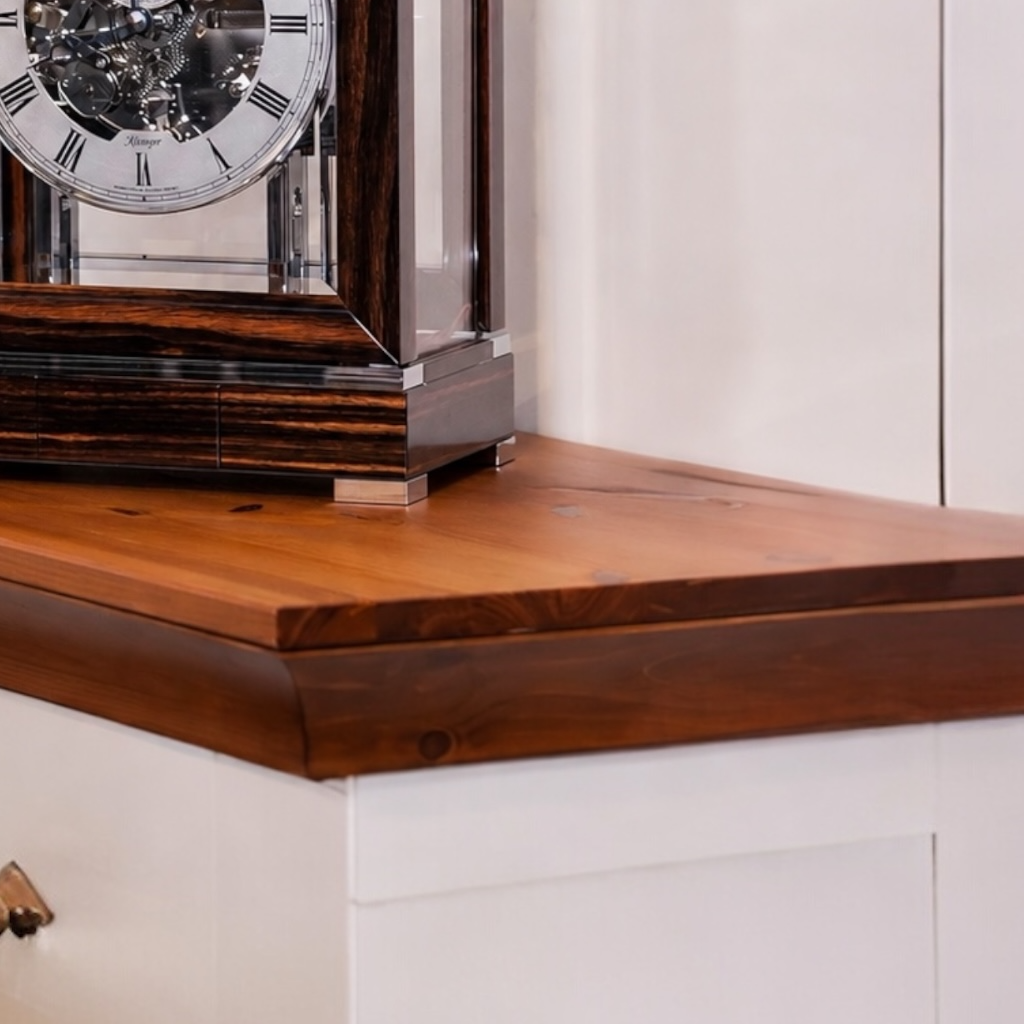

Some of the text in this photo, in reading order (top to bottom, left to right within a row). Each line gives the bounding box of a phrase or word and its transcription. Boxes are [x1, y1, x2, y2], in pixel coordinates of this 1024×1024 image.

[269, 13, 308, 36] III
[53, 127, 87, 173] VII
[207, 137, 232, 174] V
[135, 151, 152, 186] VI
